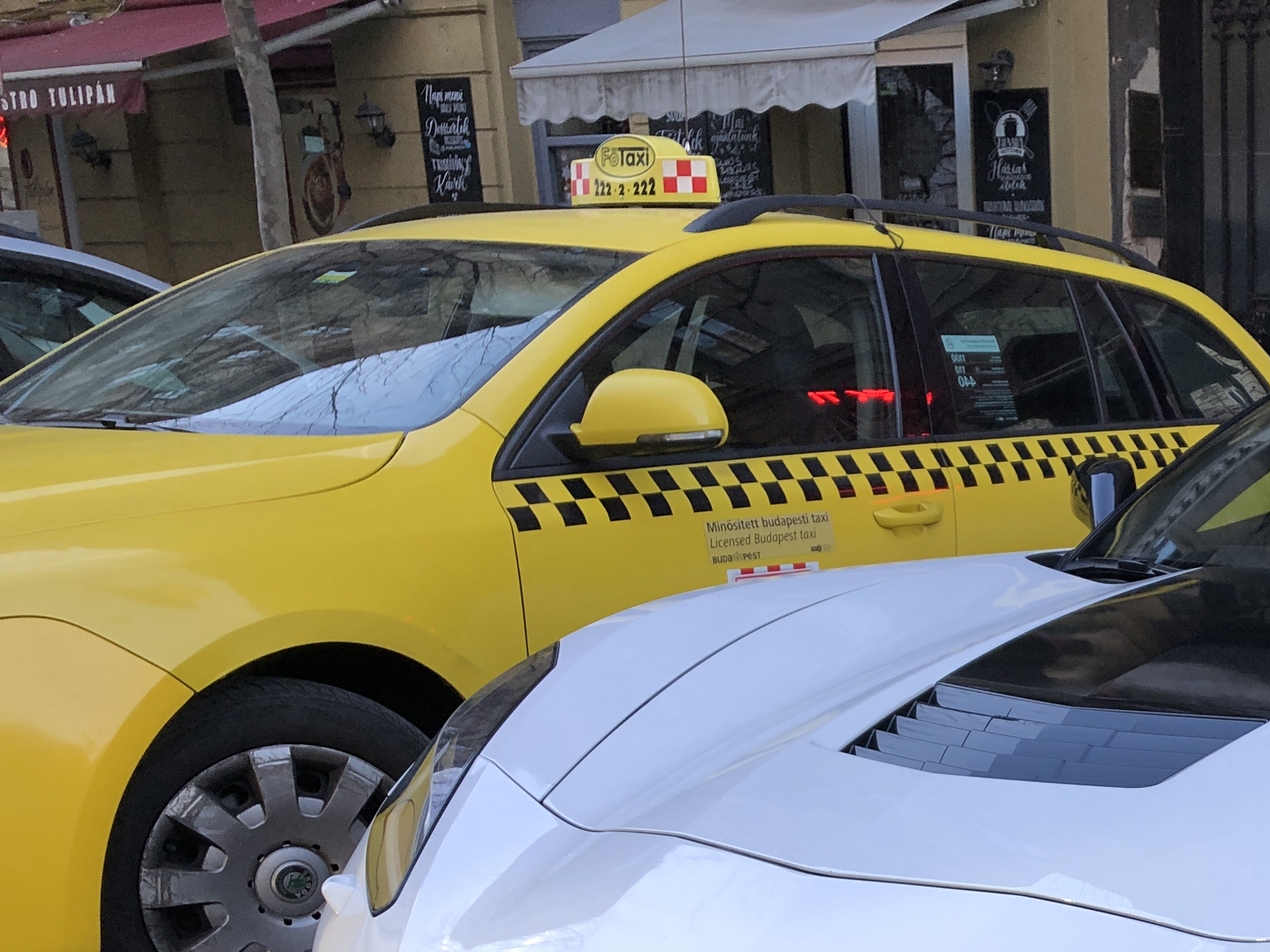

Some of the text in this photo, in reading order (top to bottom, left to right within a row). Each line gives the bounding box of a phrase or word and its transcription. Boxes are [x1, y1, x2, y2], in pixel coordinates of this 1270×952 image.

[48, 80, 116, 108] TULIPÁN
[761, 513, 810, 528] budapesti
[811, 511, 829, 523] taxi
[710, 527, 817, 549] Licensed Budapest taxi
